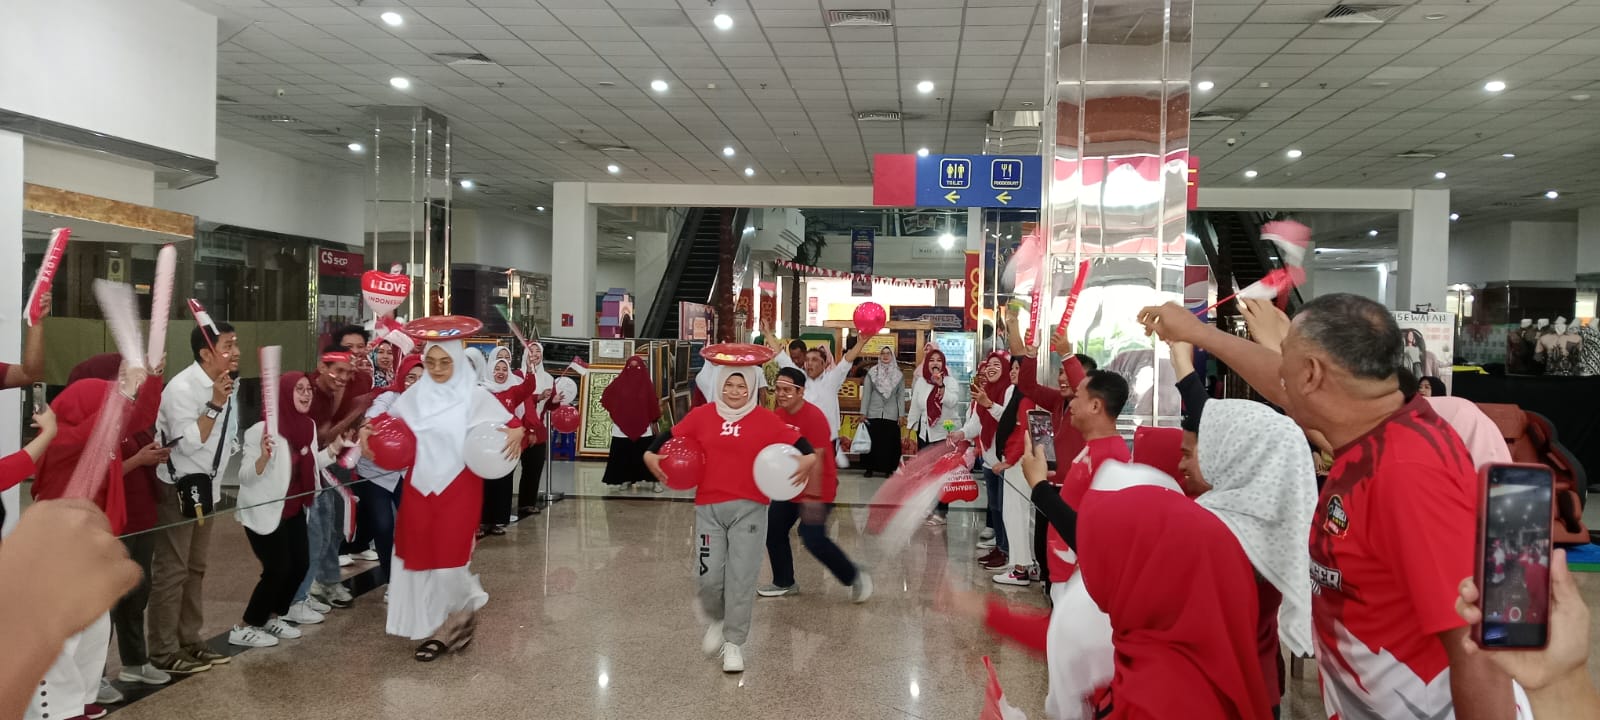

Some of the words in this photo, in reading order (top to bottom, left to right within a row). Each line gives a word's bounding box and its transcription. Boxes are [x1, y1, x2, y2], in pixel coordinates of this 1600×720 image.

[321, 250, 333, 265] CS
[370, 279, 375, 289] I
[378, 279, 406, 293] LOVE
[700, 534, 710, 576] FILA
